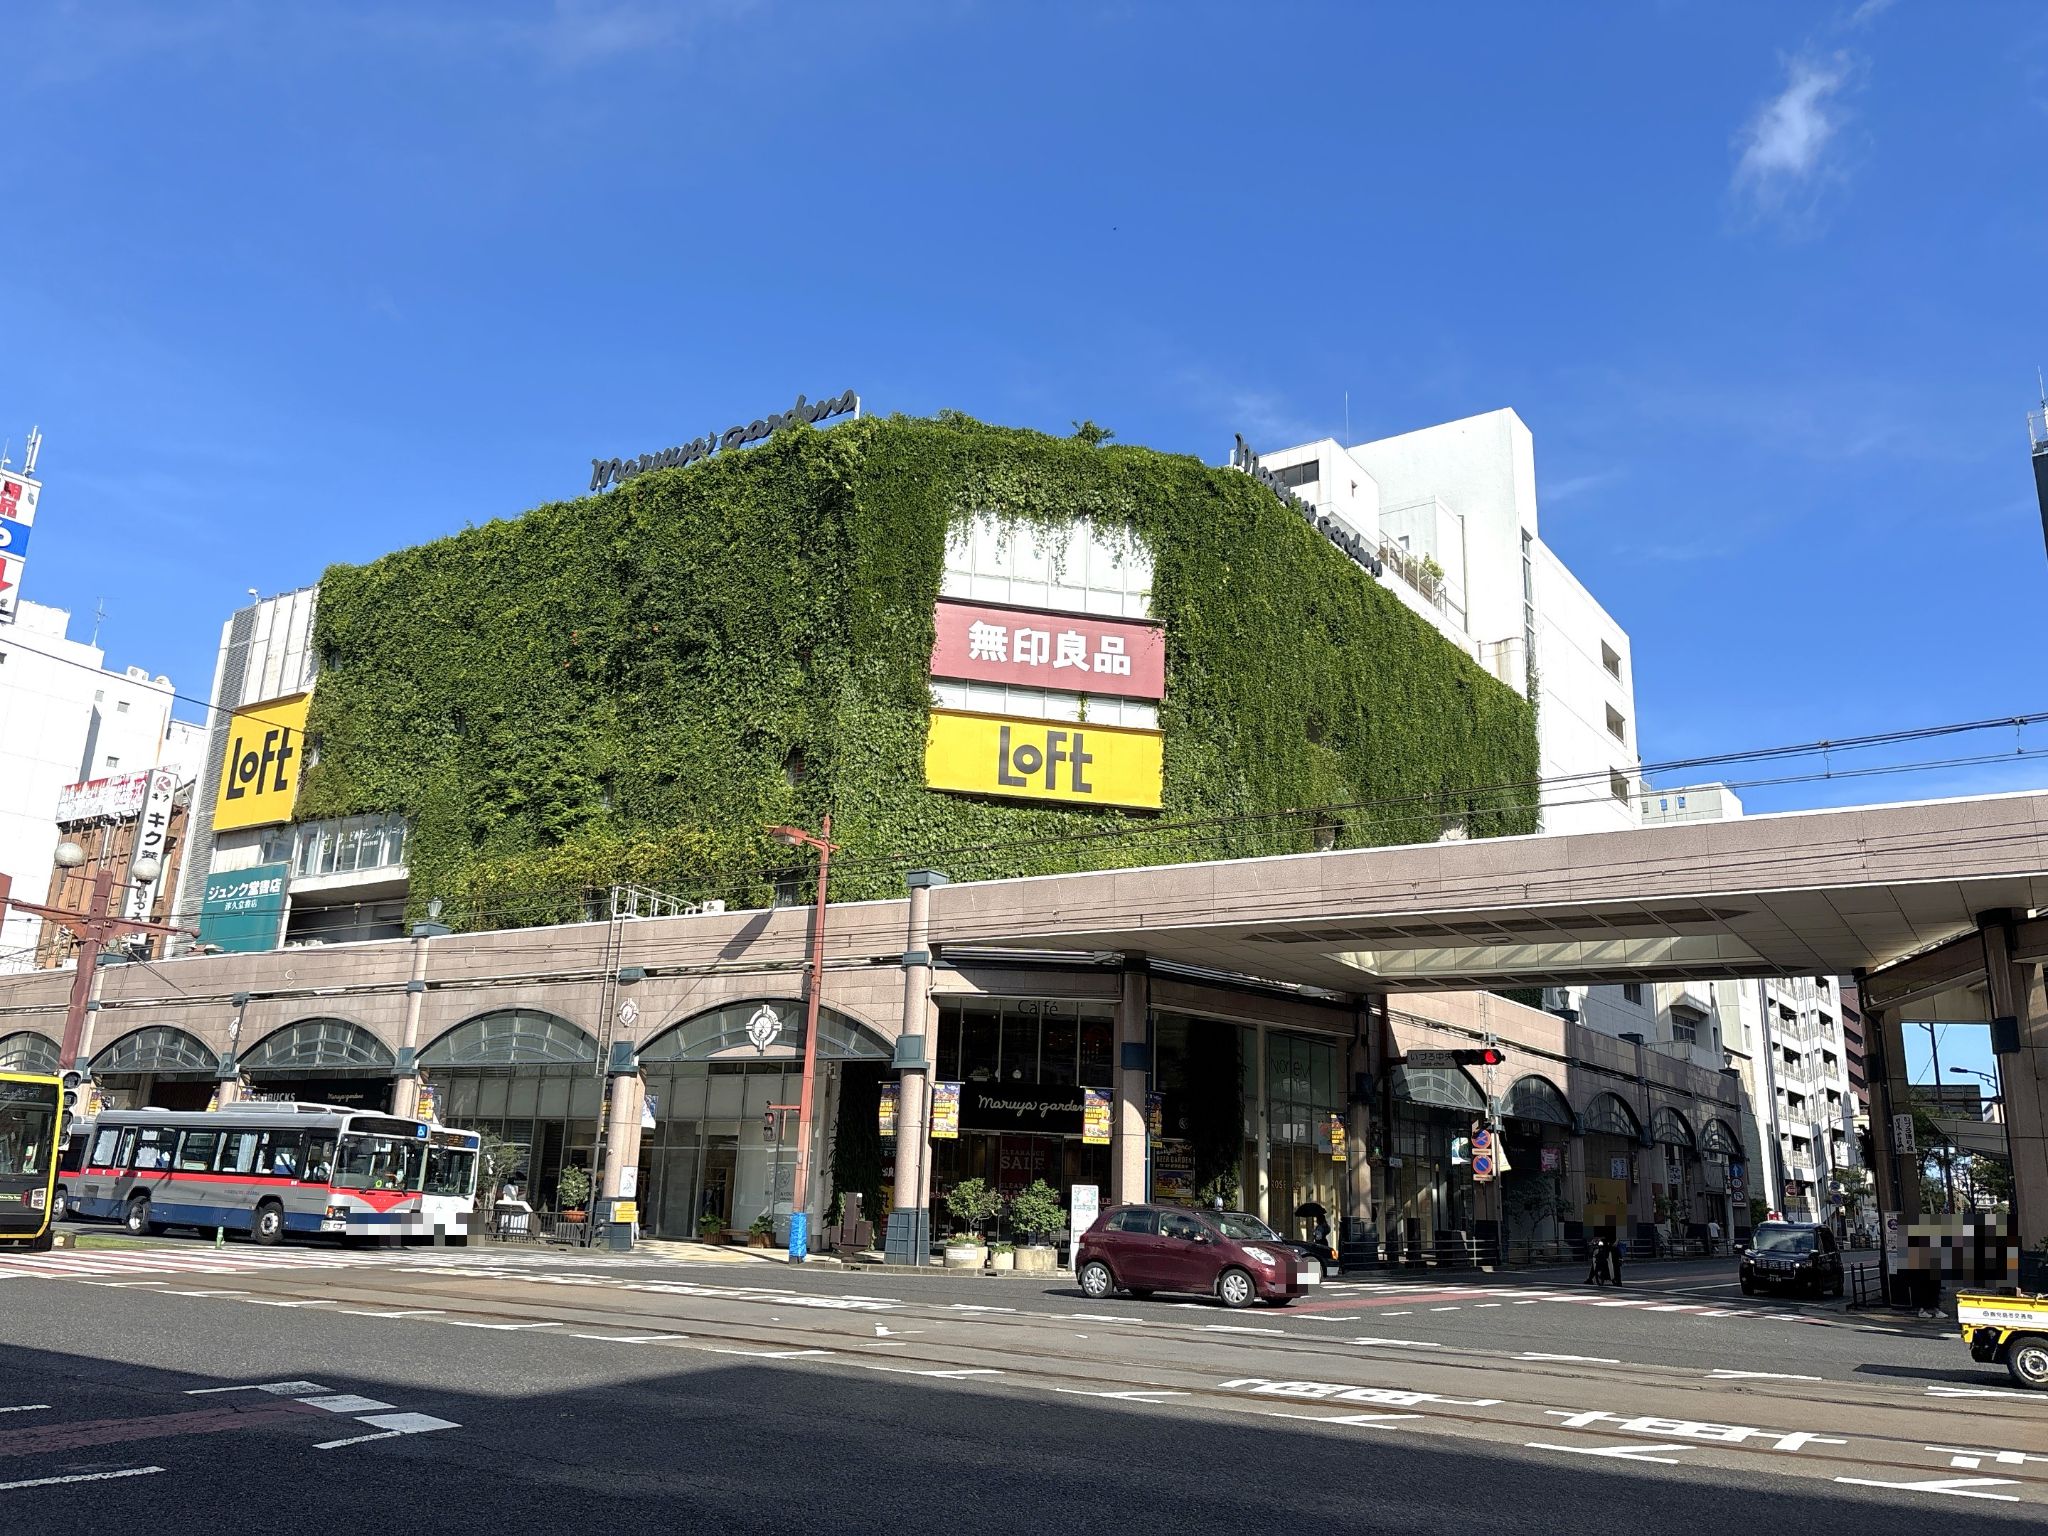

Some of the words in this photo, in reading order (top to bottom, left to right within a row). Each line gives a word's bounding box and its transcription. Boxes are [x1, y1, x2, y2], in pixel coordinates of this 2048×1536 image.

[968, 620, 1132, 676] 無印良品
[207, 878, 282, 901] ジュンク堂書店
[978, 1095, 1038, 1117] Maruya
